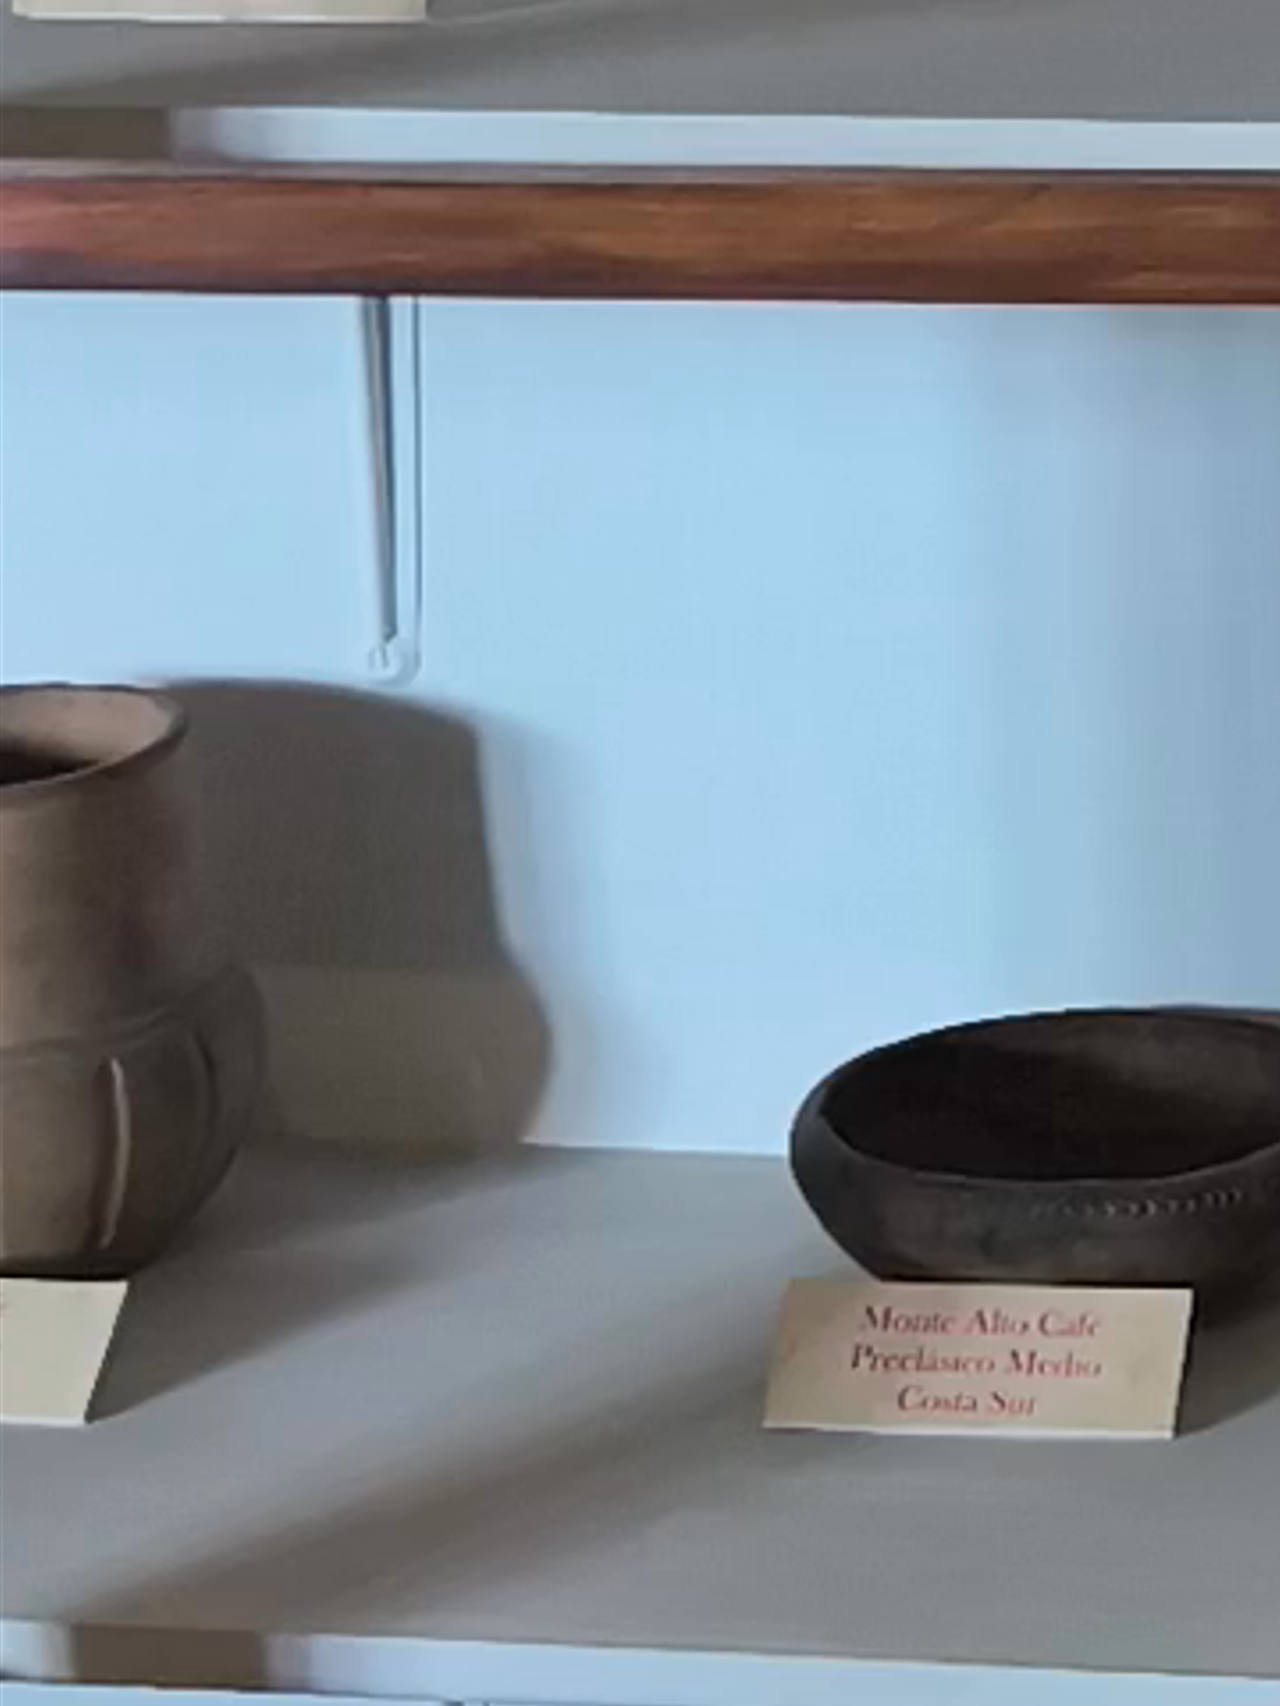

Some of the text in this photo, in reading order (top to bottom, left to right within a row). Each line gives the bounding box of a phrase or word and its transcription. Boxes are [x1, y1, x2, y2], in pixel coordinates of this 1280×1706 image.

[859, 1305, 956, 1335] Monte
[1006, 1348, 1102, 1377] Medio
[897, 1385, 1036, 1415] Costa Sur
